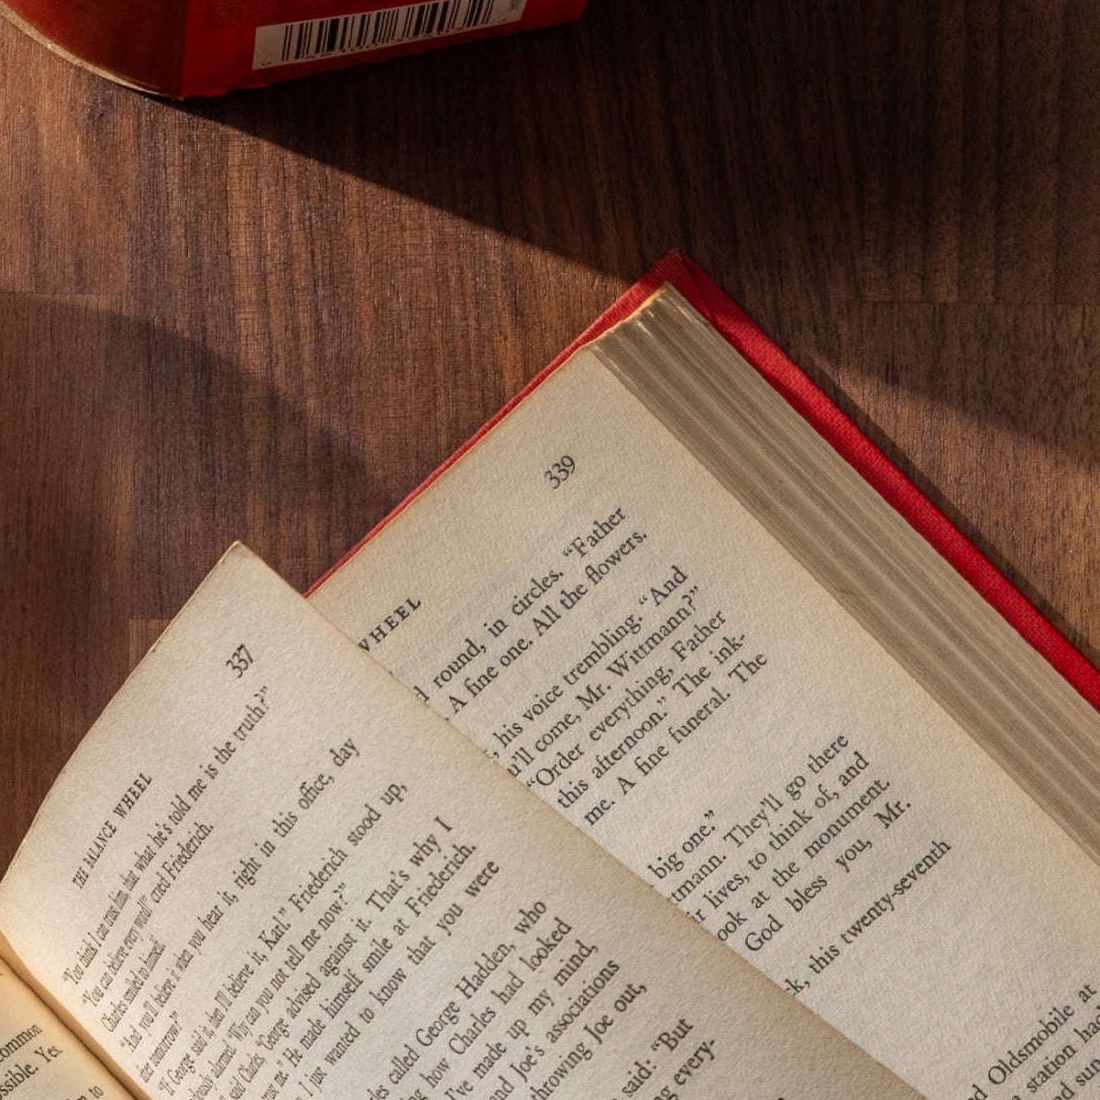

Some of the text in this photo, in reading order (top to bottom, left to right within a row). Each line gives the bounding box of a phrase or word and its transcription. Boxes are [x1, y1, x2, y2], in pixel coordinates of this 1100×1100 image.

[543, 454, 576, 490] 339
[225, 643, 254, 679] 337
[432, 637, 487, 690] round,
[487, 618, 509, 639] in
[511, 569, 565, 616] circles.
[448, 694, 469, 717] A
[463, 666, 500, 698] fine
[499, 638, 534, 668] one.
[532, 604, 562, 637] All
[559, 583, 589, 611] the
[584, 531, 648, 586] flowers.
[494, 722, 524, 749] his
[521, 685, 564, 722] voice
[562, 614, 644, 686] trembling.
[588, 665, 674, 742] everything,
[670, 610, 727, 663] Father
[533, 710, 584, 756] come,
[574, 683, 612, 712] Mr.
[558, 779, 589, 808] this
[671, 666, 712, 698] The
[713, 634, 746, 666] ink-
[583, 653, 768, 827] me. A fine funeral. The
[71, 772, 153, 890] THE BALANCE WHEEL
[133, 844, 157, 872] what
[167, 793, 192, 826] told
[187, 778, 208, 803] me
[199, 763, 219, 781] is
[212, 741, 237, 765] the
[161, 821, 215, 881] Friederich.
[196, 904, 225, 932] hear
[233, 857, 263, 890] right
[253, 840, 277, 858] in
[271, 810, 299, 838] this
[298, 773, 335, 810] office,
[329, 738, 360, 768] day
[287, 847, 349, 914] Friederich
[347, 803, 382, 847] stood
[379, 783, 408, 806] up,
[647, 851, 685, 880] big
[666, 854, 727, 903] tmann.
[784, 775, 807, 801] go
[807, 734, 849, 775] there
[702, 750, 870, 910] lives, to think of, and
[750, 890, 771, 910] at
[771, 861, 801, 888] the
[803, 779, 891, 860] monument.
[285, 971, 322, 1020] advised
[319, 932, 358, 978] against
[349, 915, 374, 935] it.
[408, 833, 442, 867] why
[433, 815, 453, 833] I
[744, 913, 784, 952] God
[784, 875, 828, 913] bless
[834, 838, 873, 874] you,
[873, 800, 912, 830] Mr.
[808, 839, 953, 975] this twenty-seventh
[283, 944, 306, 971] tell
[300, 928, 322, 952] me
[299, 843, 477, 1051] made himself smile at Friederich.
[324, 860, 500, 1066] wanted to know that you were
[388, 900, 547, 1085] called George Hadden, who
[419, 915, 573, 1089] how Charles had looked
[472, 939, 599, 1080] made up my mind,
[545, 959, 621, 1044] associations
[529, 983, 648, 1100] throwing Joe out,
[621, 1059, 658, 1098] said:
[672, 1039, 716, 1087] every-
[987, 983, 1098, 1086] Oldsmobile at
[1026, 1044, 1078, 1094] station
